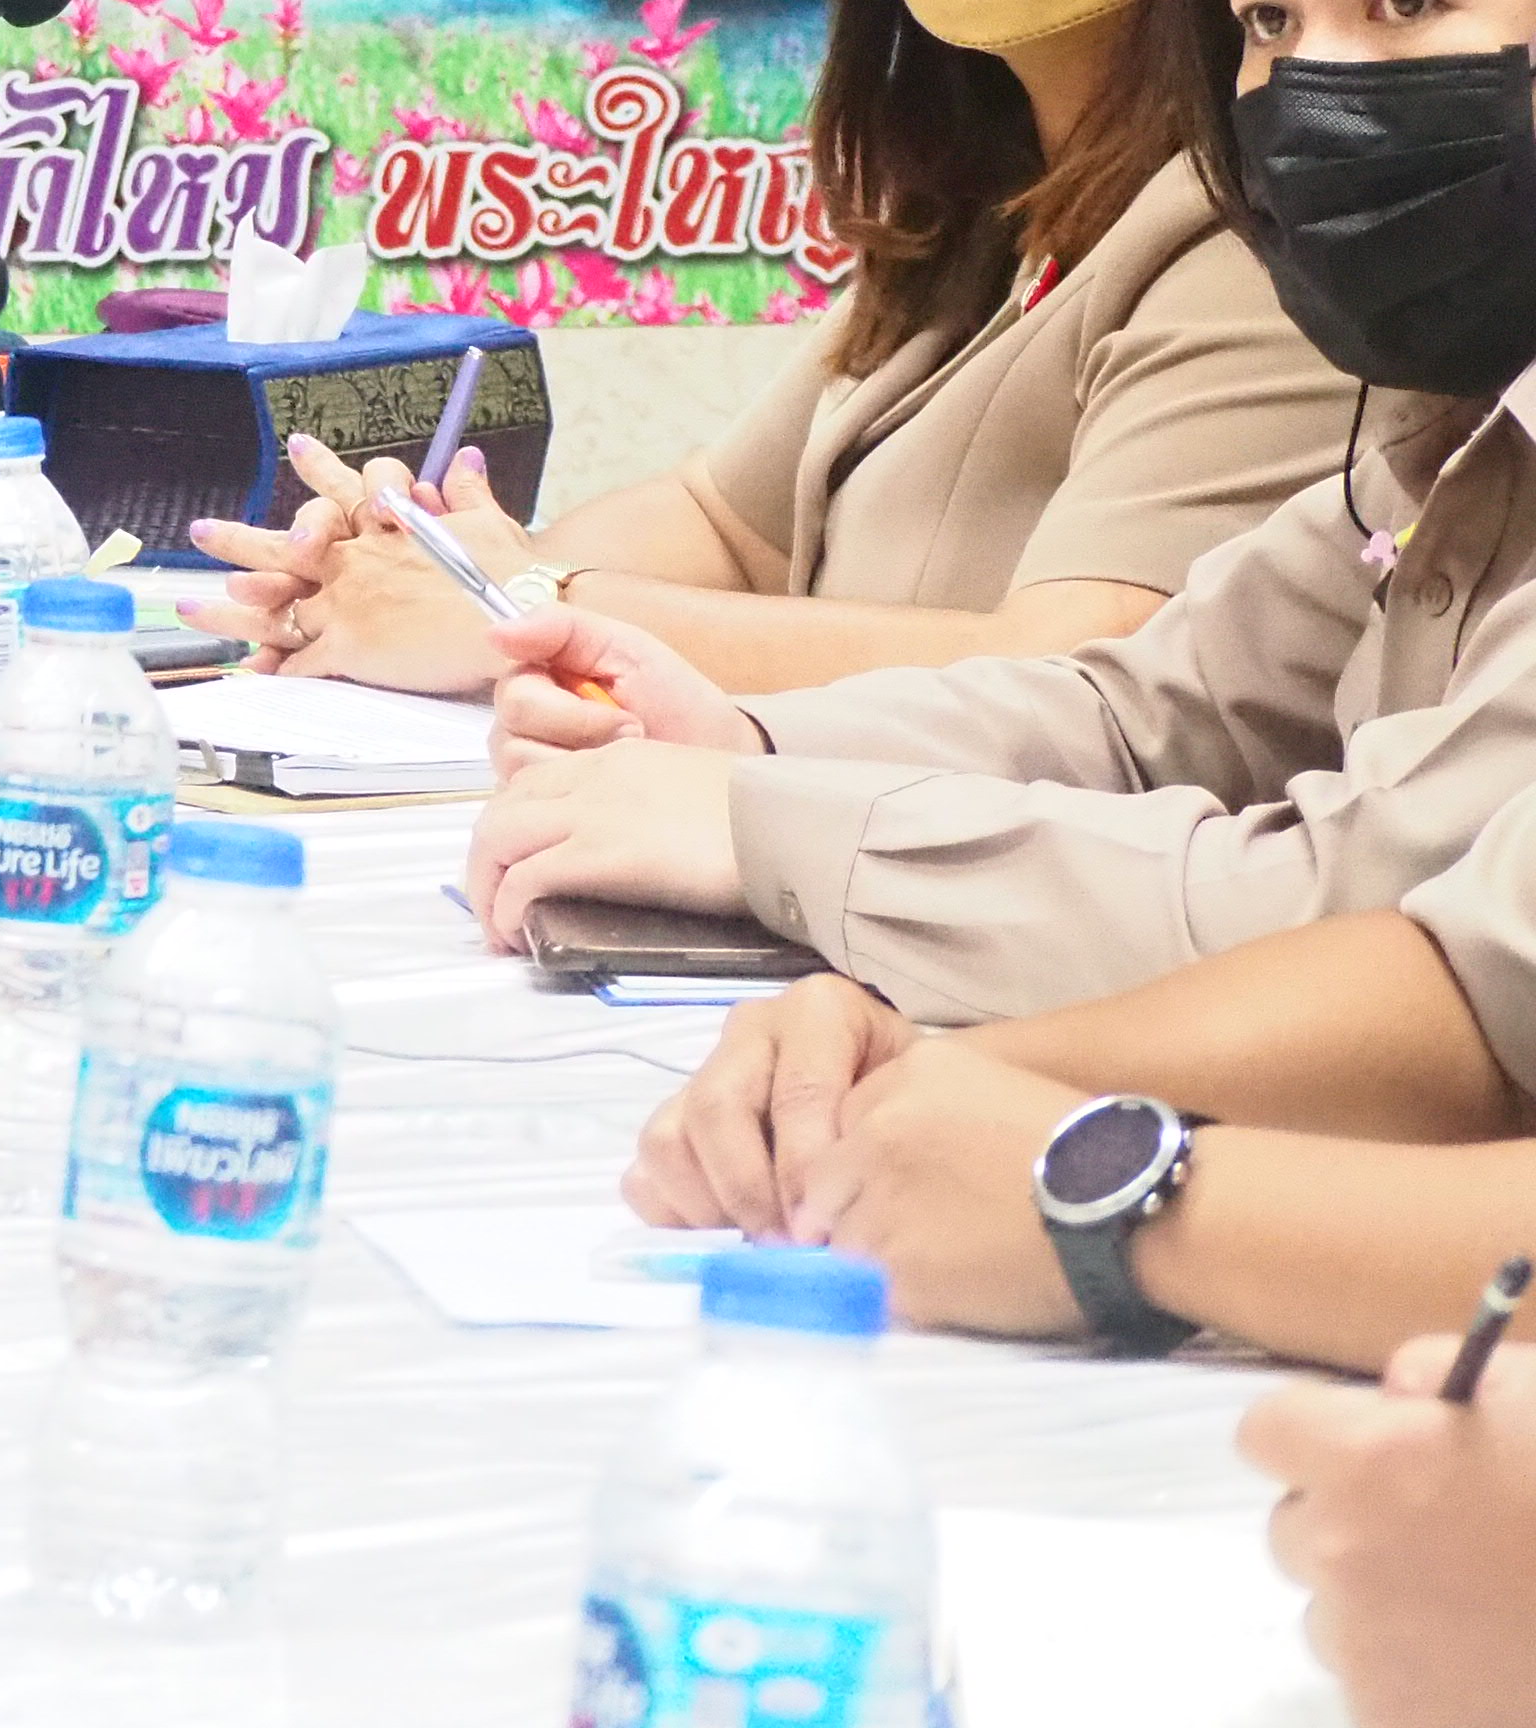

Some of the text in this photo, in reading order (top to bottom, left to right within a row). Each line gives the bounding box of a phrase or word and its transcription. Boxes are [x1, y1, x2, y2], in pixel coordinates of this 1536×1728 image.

[366, 66, 856, 282] พระใหญ
[45, 847, 101, 891] Life
